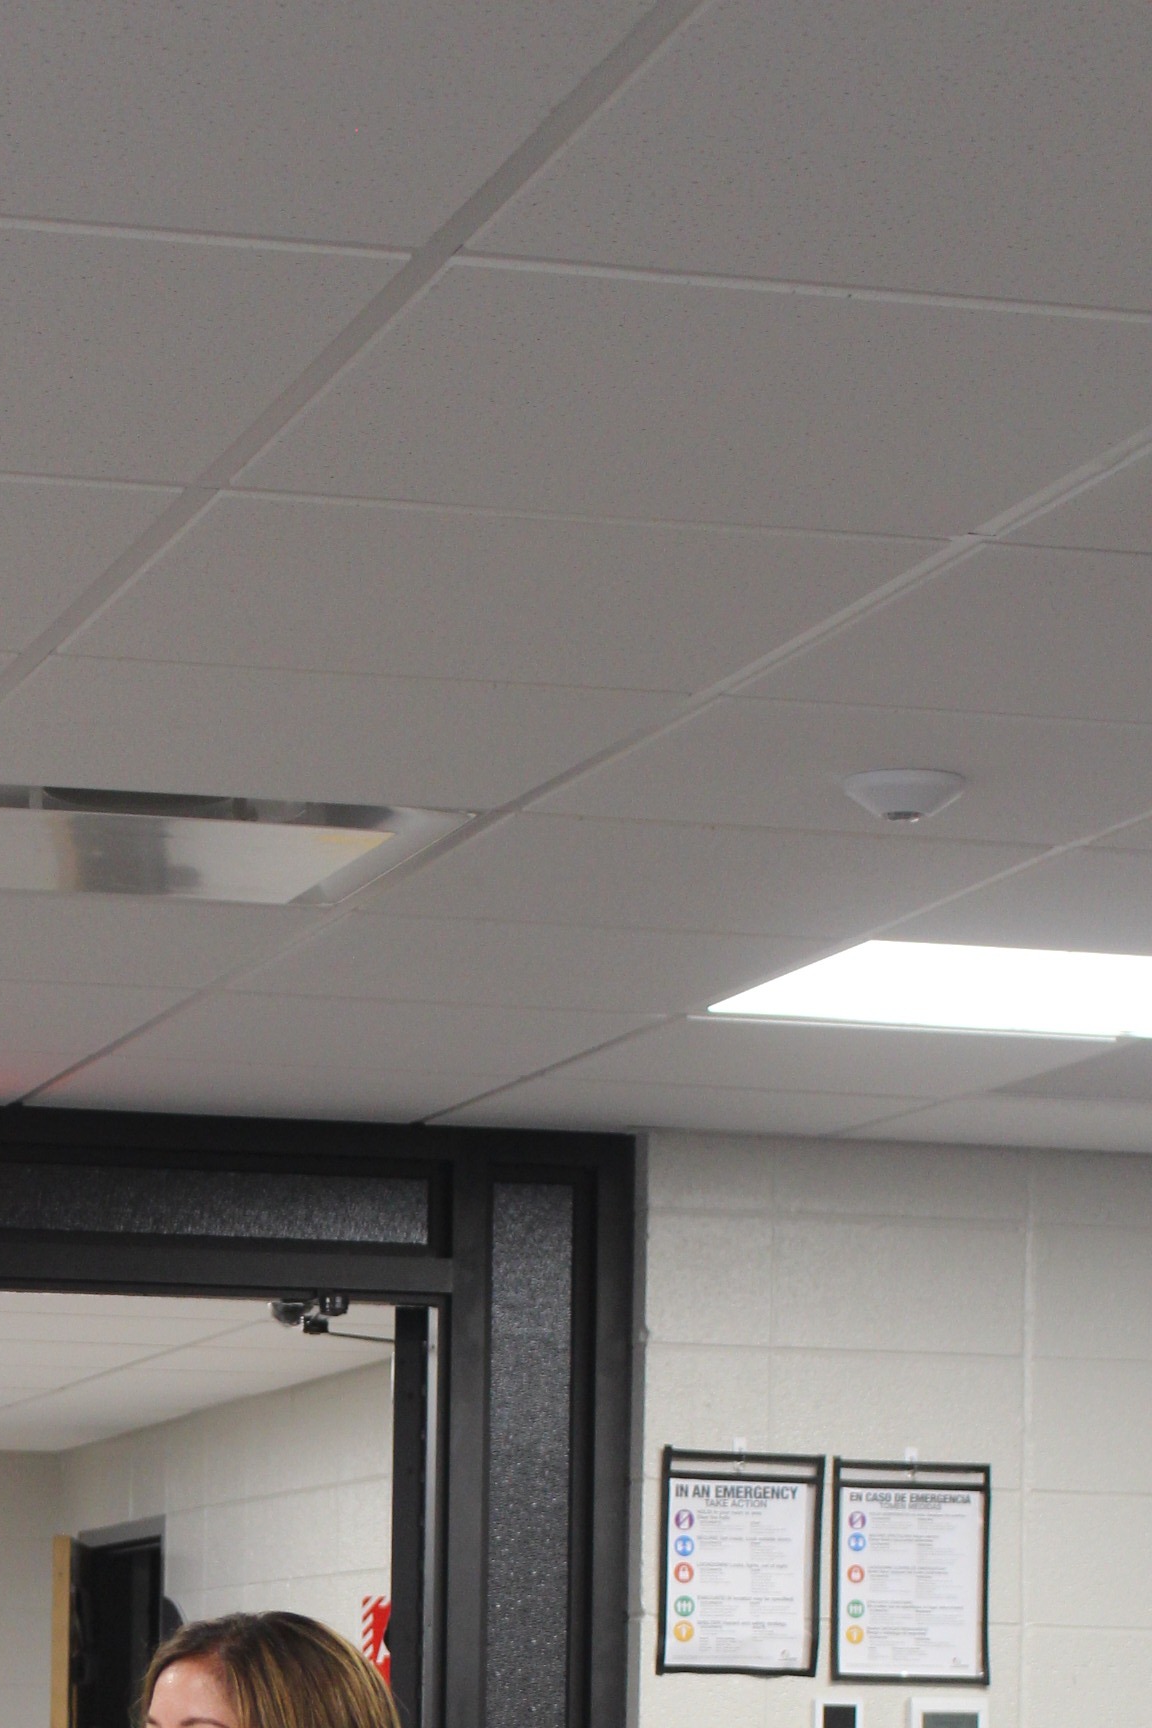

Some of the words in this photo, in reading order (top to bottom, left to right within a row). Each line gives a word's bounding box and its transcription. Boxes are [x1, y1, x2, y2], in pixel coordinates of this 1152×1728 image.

[675, 1483, 688, 1498] IN
[692, 1484, 710, 1499] AN
[715, 1485, 798, 1500] EMERGENCY
[849, 1492, 863, 1501] EN
[865, 1492, 892, 1502] CASO
[894, 1492, 907, 1503] DE
[705, 1499, 728, 1508] TAKE
[730, 1499, 768, 1509] ACTION
